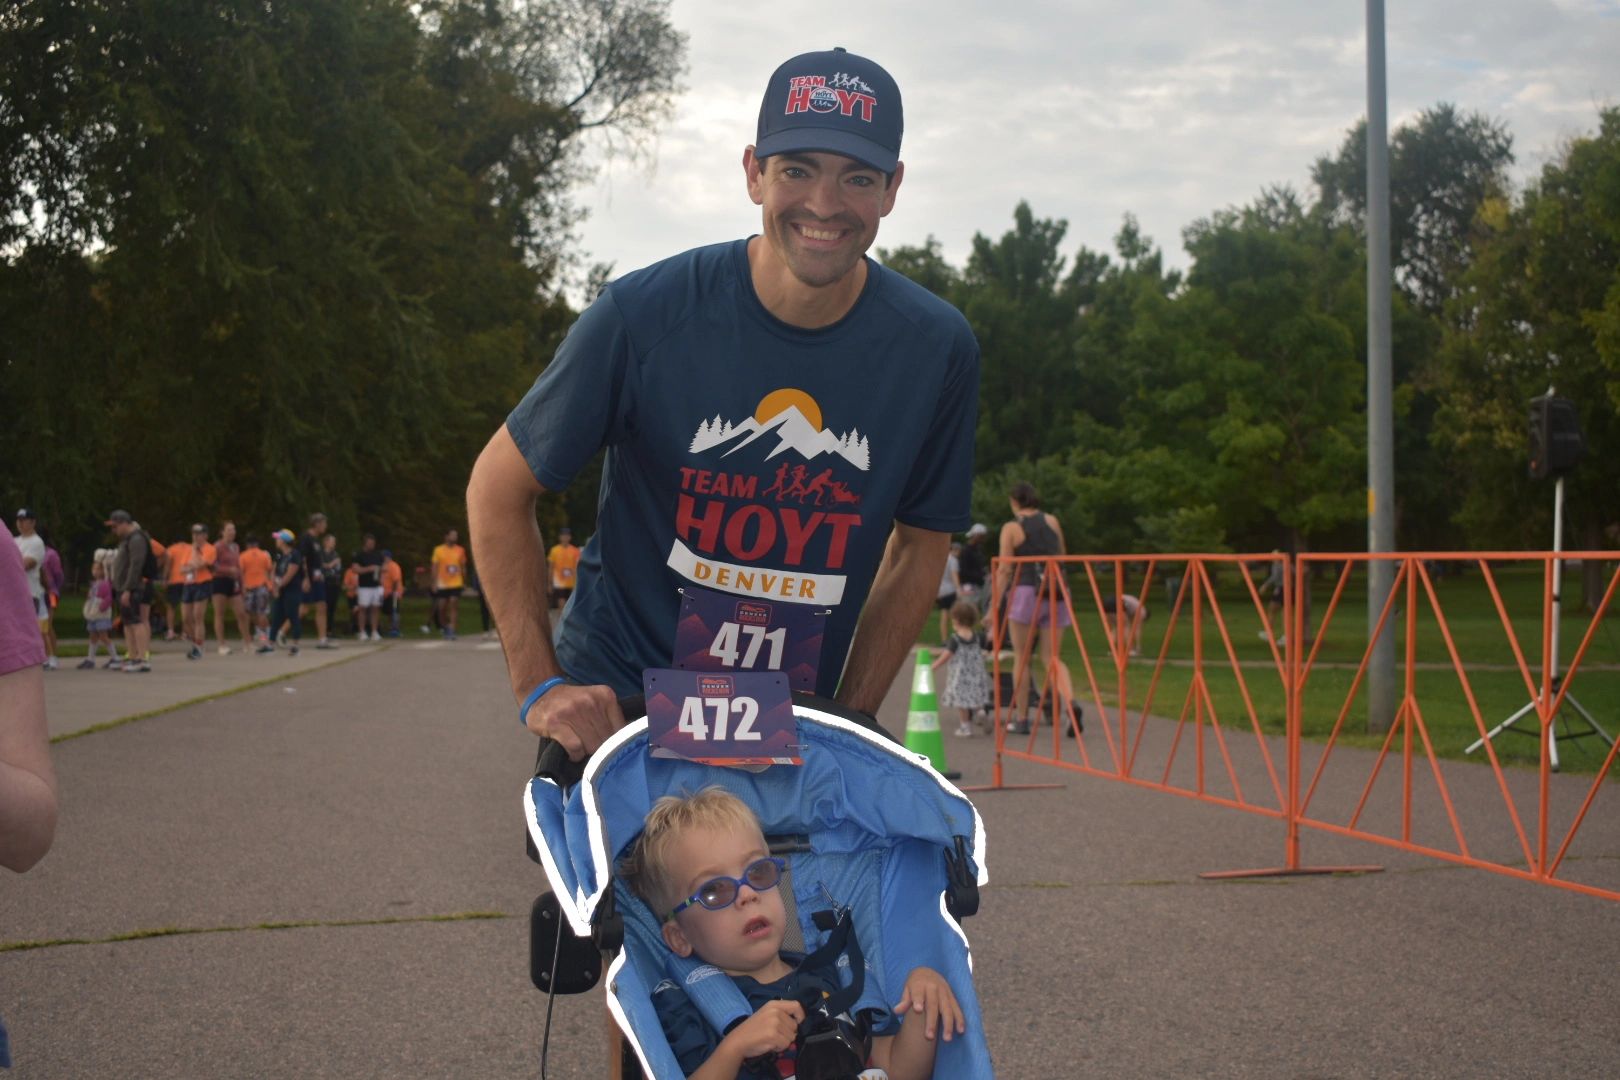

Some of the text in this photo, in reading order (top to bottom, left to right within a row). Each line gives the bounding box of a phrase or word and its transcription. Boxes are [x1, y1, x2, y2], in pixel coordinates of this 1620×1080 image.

[790, 76, 826, 88] TEAM
[785, 86, 877, 122] HOYT
[680, 466, 758, 499] TEAM
[676, 492, 862, 569] HOYT
[694, 561, 816, 599] DENVER
[709, 621, 787, 670] 471
[678, 696, 762, 741] 472
